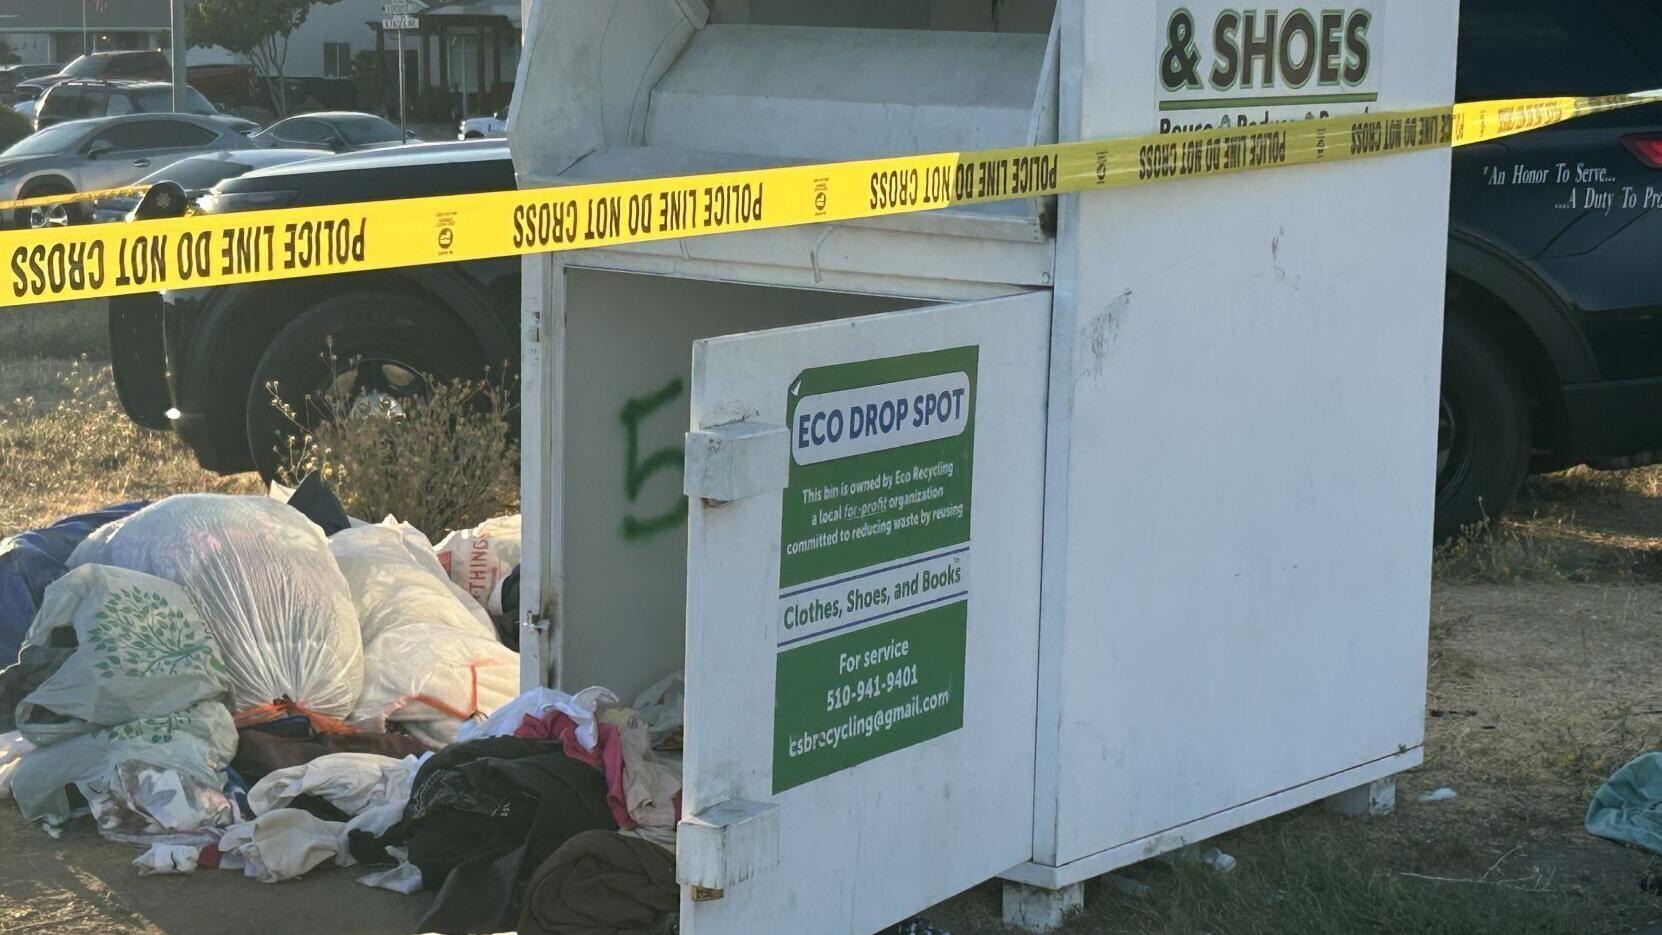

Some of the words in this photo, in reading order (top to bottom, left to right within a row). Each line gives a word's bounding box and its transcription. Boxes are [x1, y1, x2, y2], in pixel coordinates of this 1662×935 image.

[1160, 8, 1204, 91] &
[1209, 8, 1372, 91] SHOES
[1180, 141, 1201, 175] NOT
[1224, 137, 1247, 169] LINE
[1250, 131, 1286, 164] POLICE
[1350, 121, 1382, 155] CROSS
[955, 163, 974, 201] DO
[978, 160, 1008, 198] LINE
[1012, 153, 1058, 194] POLICE
[1139, 143, 1177, 180] CROSS
[1512, 164, 1549, 184] Honor
[1556, 162, 1571, 183] To
[703, 182, 763, 227] POLICE
[870, 168, 918, 210] CROSS
[923, 165, 951, 203] NOT
[1584, 187, 1614, 216] Duty
[1622, 186, 1637, 208] To
[513, 199, 578, 249] CROSS
[584, 196, 622, 240] NOT
[628, 193, 652, 236] DO
[659, 189, 697, 232] LINE
[115, 235, 168, 286] NOT
[177, 231, 212, 280] DO
[221, 225, 275, 276] LINE
[284, 216, 367, 270] POLICE
[10, 239, 105, 298] CROSS
[798, 408, 844, 449] ECO
[849, 398, 908, 439] DROP
[912, 388, 965, 428] SPOT
[619, 378, 689, 541] 5
[803, 488, 822, 504] This
[824, 484, 839, 500] bin
[841, 482, 848, 497] is
[850, 475, 880, 494] owned
[882, 470, 893, 488] by
[895, 470, 911, 485] Eco
[912, 461, 953, 482] Recycling
[811, 515, 817, 526] a
[819, 505, 842, 524] local
[845, 496, 888, 518] for-profit
[888, 486, 944, 510] organization
[786, 529, 839, 556] committed
[840, 530, 850, 543] to
[851, 518, 893, 540] reducing
[893, 511, 919, 529] waste
[920, 508, 932, 526] by
[932, 502, 964, 520] reusing
[783, 597, 843, 630] Clothes,
[846, 586, 891, 613] Shoes,
[894, 572, 919, 600] and
[922, 564, 961, 592] Books
[839, 652, 861, 675] For
[863, 638, 909, 668] service
[826, 663, 918, 712] 510-941-9401
